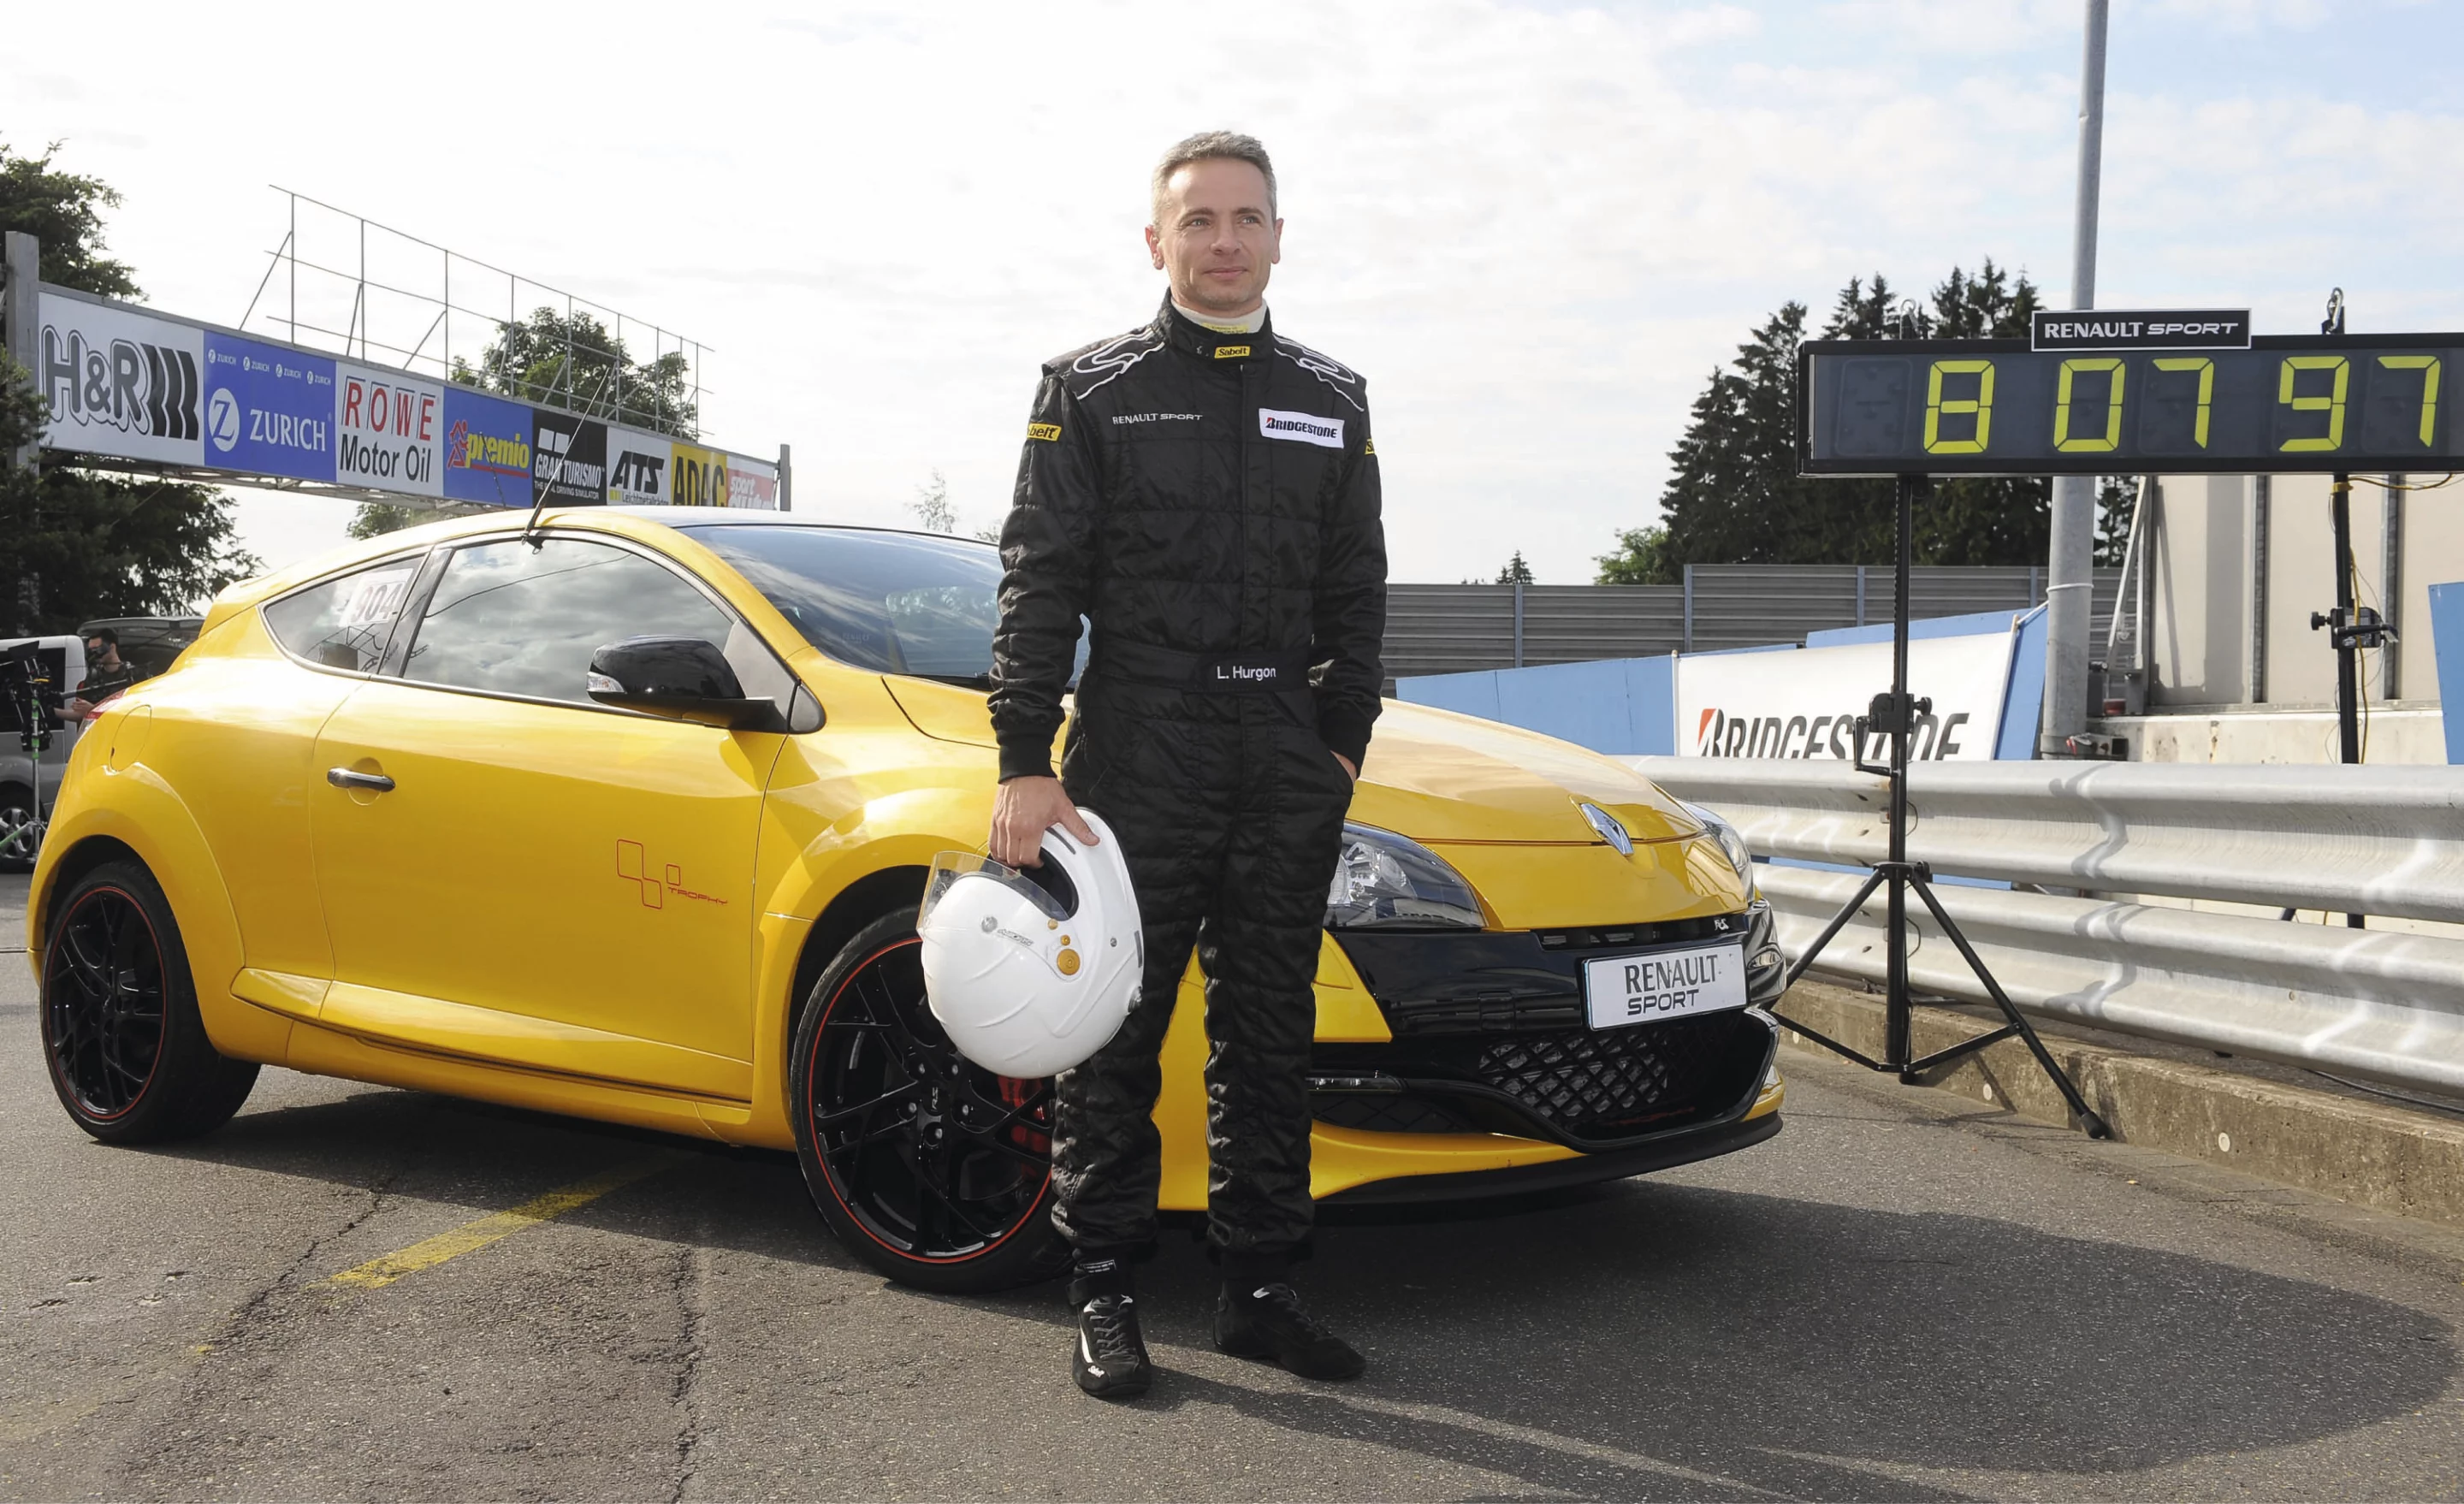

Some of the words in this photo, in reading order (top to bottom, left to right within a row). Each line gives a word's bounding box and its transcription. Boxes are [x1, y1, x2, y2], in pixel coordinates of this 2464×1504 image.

[2044, 322, 2143, 339] RENAULT
[2147, 323, 2239, 335] SPORT
[216, 353, 237, 365] ZURICH
[252, 361, 270, 372] ZURICH
[283, 368, 302, 380] ZURICH
[314, 375, 332, 386] ZURICH
[1218, 346, 1247, 357] Sabelt
[42, 324, 150, 435] H&R
[344, 381, 435, 441] ROWE
[1112, 412, 1159, 425] RENAULT
[1922, 359, 1995, 454] 8
[249, 408, 327, 453] ZURICH
[1029, 424, 1058, 439] belt
[1265, 417, 1338, 439] BRIDGESTONE
[340, 433, 400, 478] Motor
[405, 444, 432, 483] Oil
[465, 432, 530, 469] premio
[535, 453, 564, 482] GRAN
[563, 459, 601, 489] TURISMO
[609, 450, 665, 494] ATS
[673, 455, 726, 507] ADAC
[730, 476, 755, 495] sport
[1217, 666, 1229, 679] L.
[1232, 665, 1276, 682] Hurgon
[1697, 708, 1970, 761] BRIDGESNE
[667, 886, 728, 906] TROPHY
[1624, 953, 1719, 995] RENAULT
[1627, 989, 1700, 1016] SPORT
